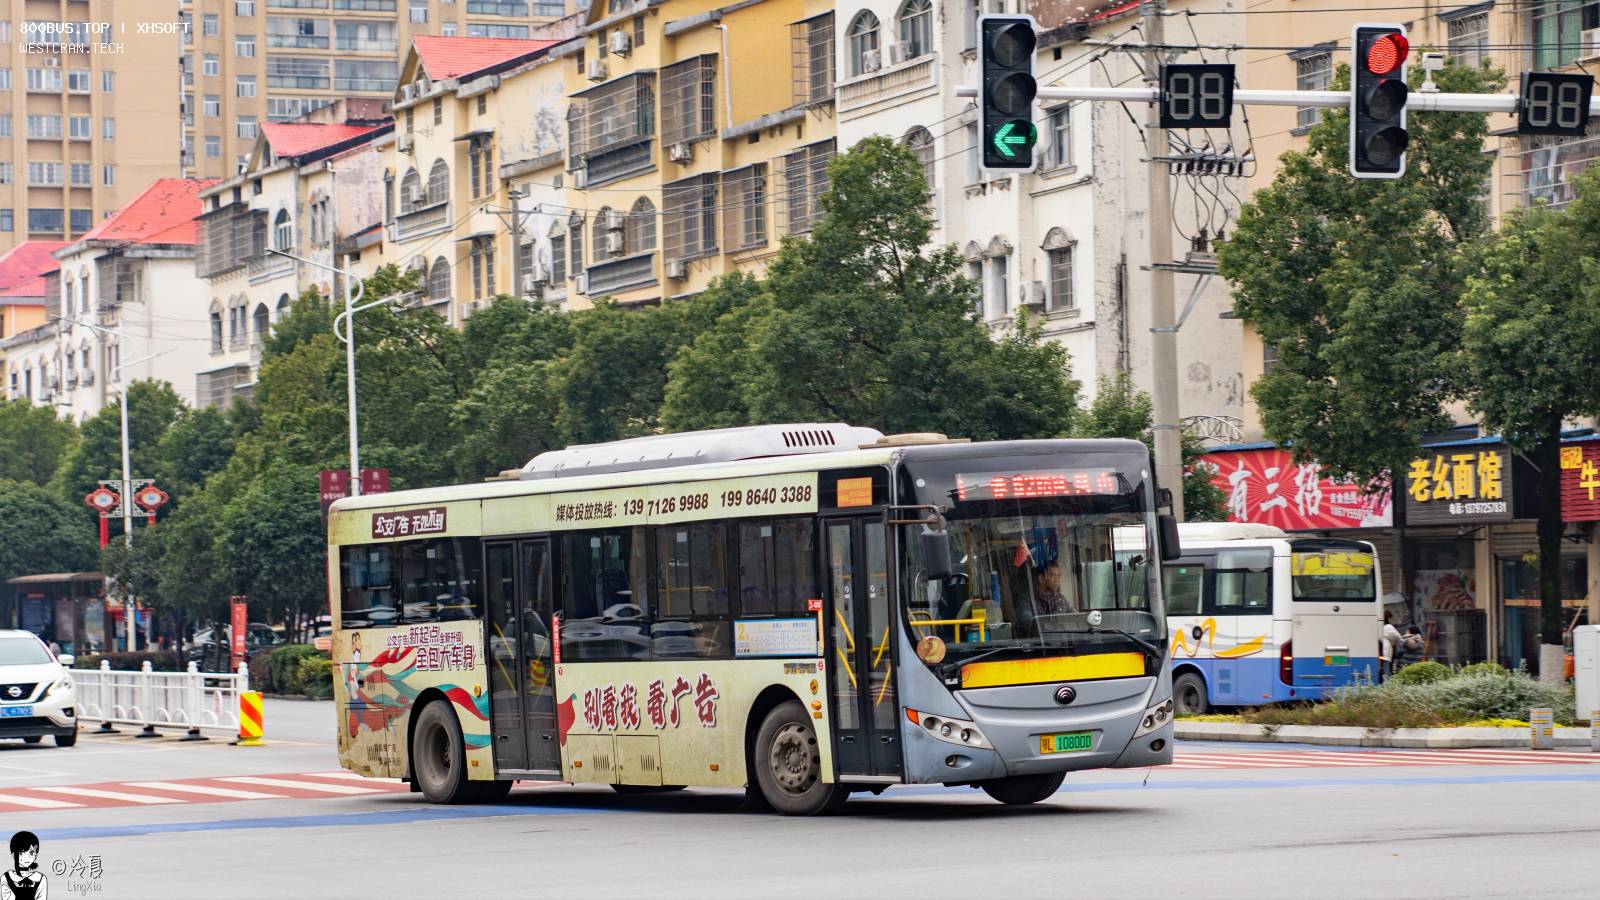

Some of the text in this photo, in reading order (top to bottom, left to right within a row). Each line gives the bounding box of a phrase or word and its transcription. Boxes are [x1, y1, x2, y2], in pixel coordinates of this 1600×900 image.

[623, 498, 644, 516] 139
[647, 496, 676, 516] 7126
[679, 493, 709, 512] 9988
[720, 490, 742, 508] 199
[746, 488, 777, 505] 8640
[780, 485, 812, 503] 3388
[374, 515, 410, 536] 公交广告
[416, 643, 475, 671] 全包大车身
